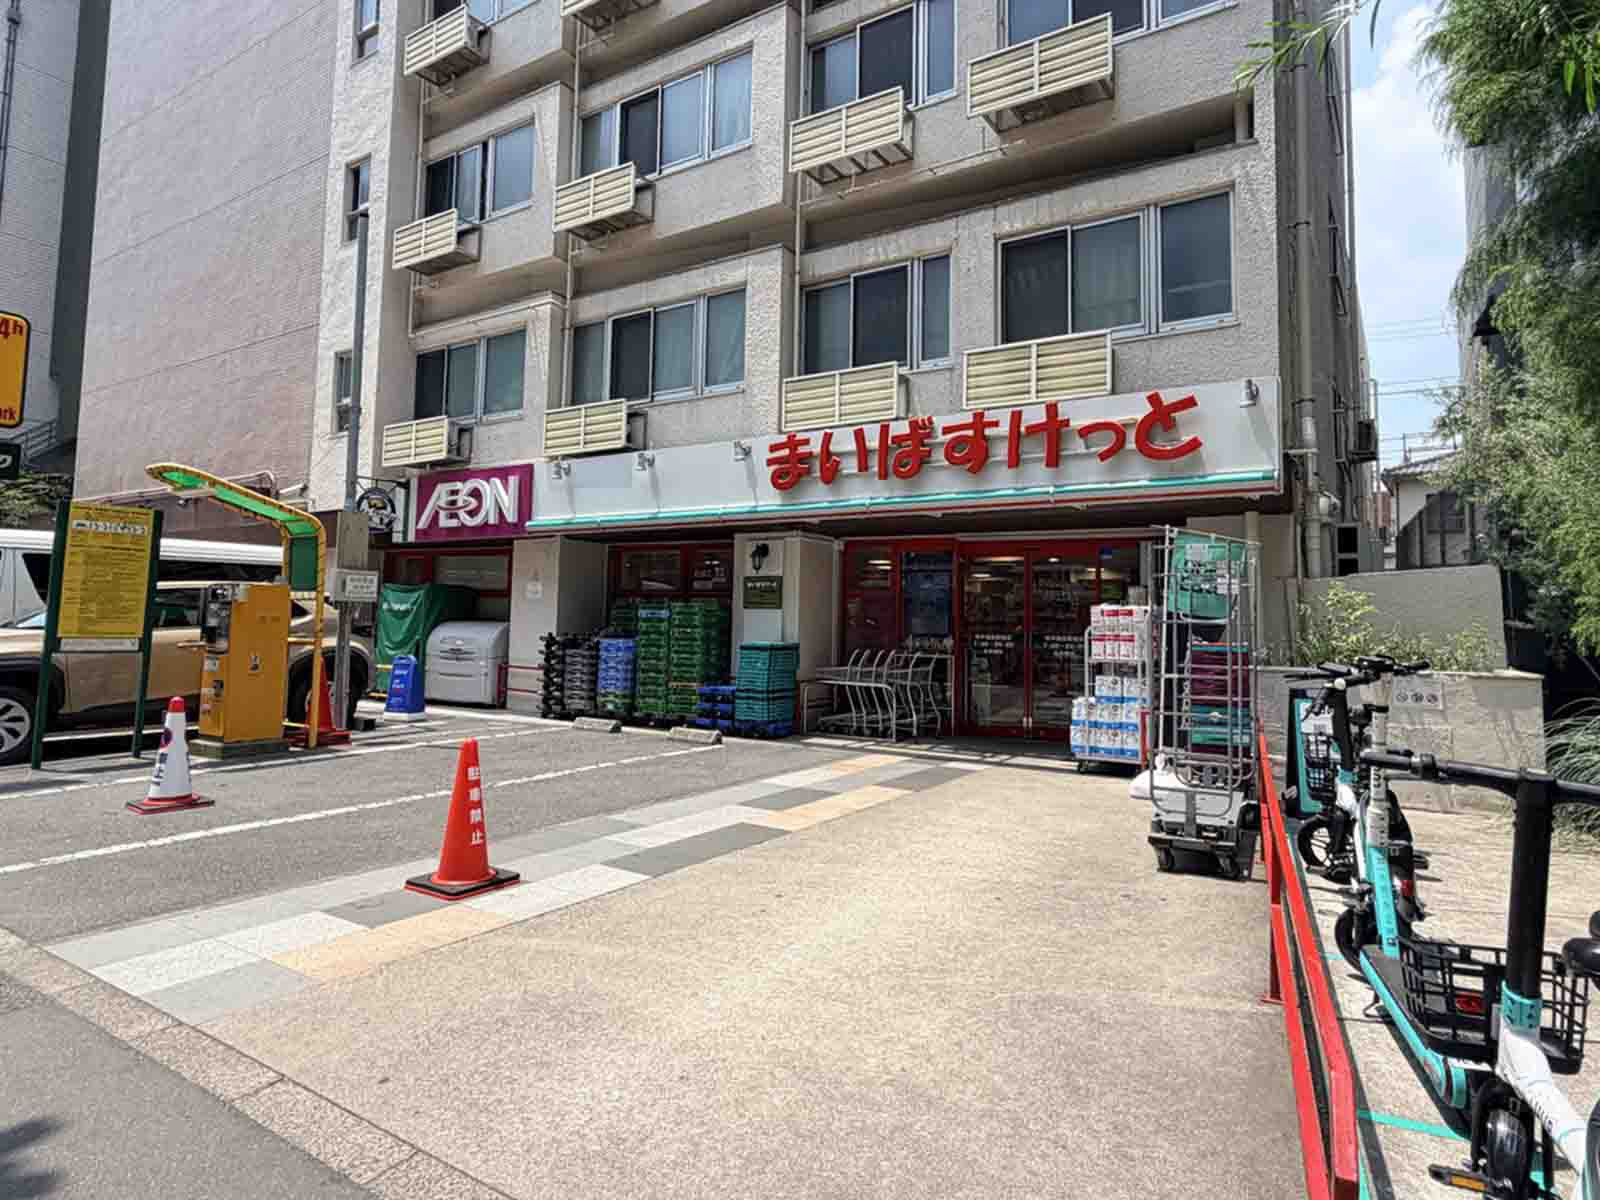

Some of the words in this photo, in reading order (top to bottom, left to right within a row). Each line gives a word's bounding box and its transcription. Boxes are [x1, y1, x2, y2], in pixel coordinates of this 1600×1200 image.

[766, 391, 1202, 491] まいばすけっと
[416, 475, 519, 529] AEON
